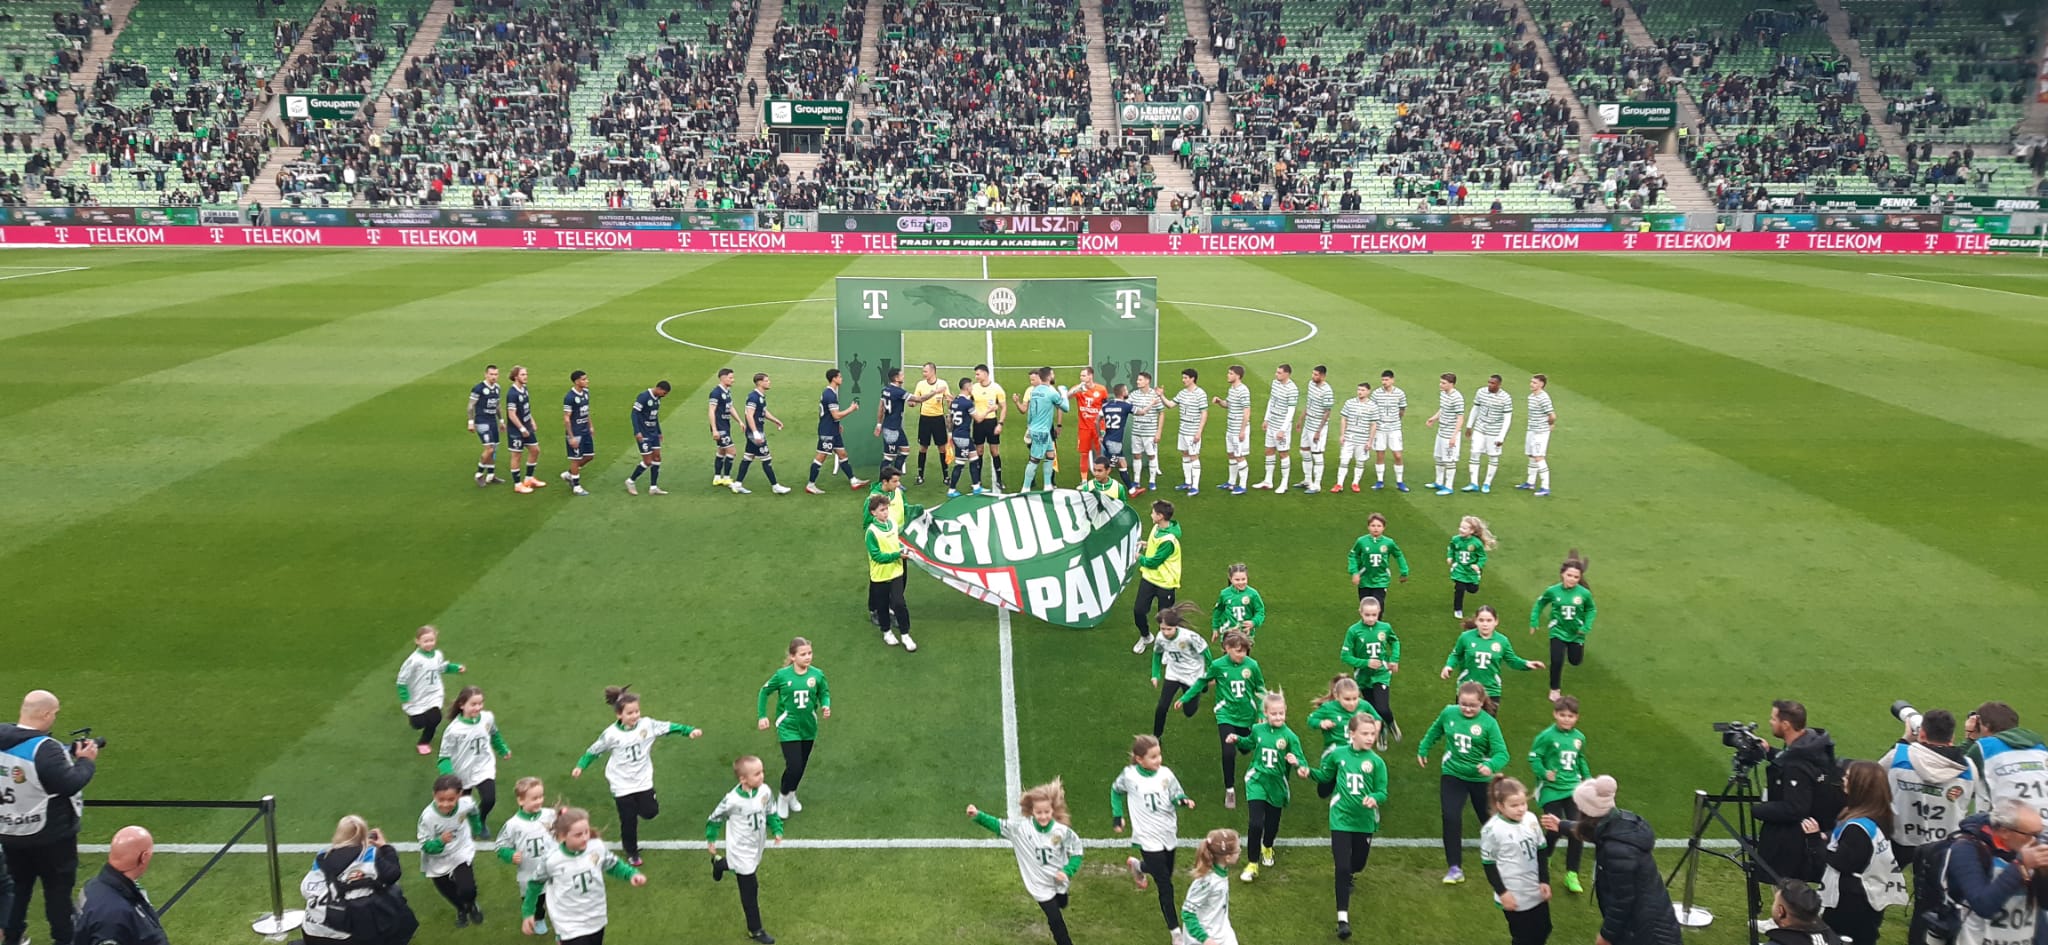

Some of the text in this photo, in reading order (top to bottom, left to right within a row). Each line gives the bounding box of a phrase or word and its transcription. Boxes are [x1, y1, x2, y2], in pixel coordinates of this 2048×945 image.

[310, 98, 360, 110] Groupama
[794, 104, 843, 115] Groupama
[1622, 105, 1671, 117] Groupama
[1770, 197, 1794, 207] PEN
[788, 215, 804, 226] C4
[86, 228, 164, 243] TELEKOM
[242, 228, 321, 244] TELEKOM
[399, 229, 477, 245] TELEKOM
[555, 231, 632, 246] TELEKOM
[709, 232, 786, 248] TELEKOM
[862, 234, 897, 250] TELE
[1001, 238, 1057, 247] AKADÉMIA
[1200, 235, 1275, 250] TELEKOM
[1350, 235, 1426, 249] TELEKOM
[1503, 234, 1579, 249] TELEKOM
[1655, 234, 1731, 249] TELEKOM
[1808, 234, 1882, 249] TELEKOM
[1956, 234, 1991, 250] TELE
[939, 316, 1066, 329] GROUPAMA ARÉNA
[1105, 414, 1121, 429] 22
